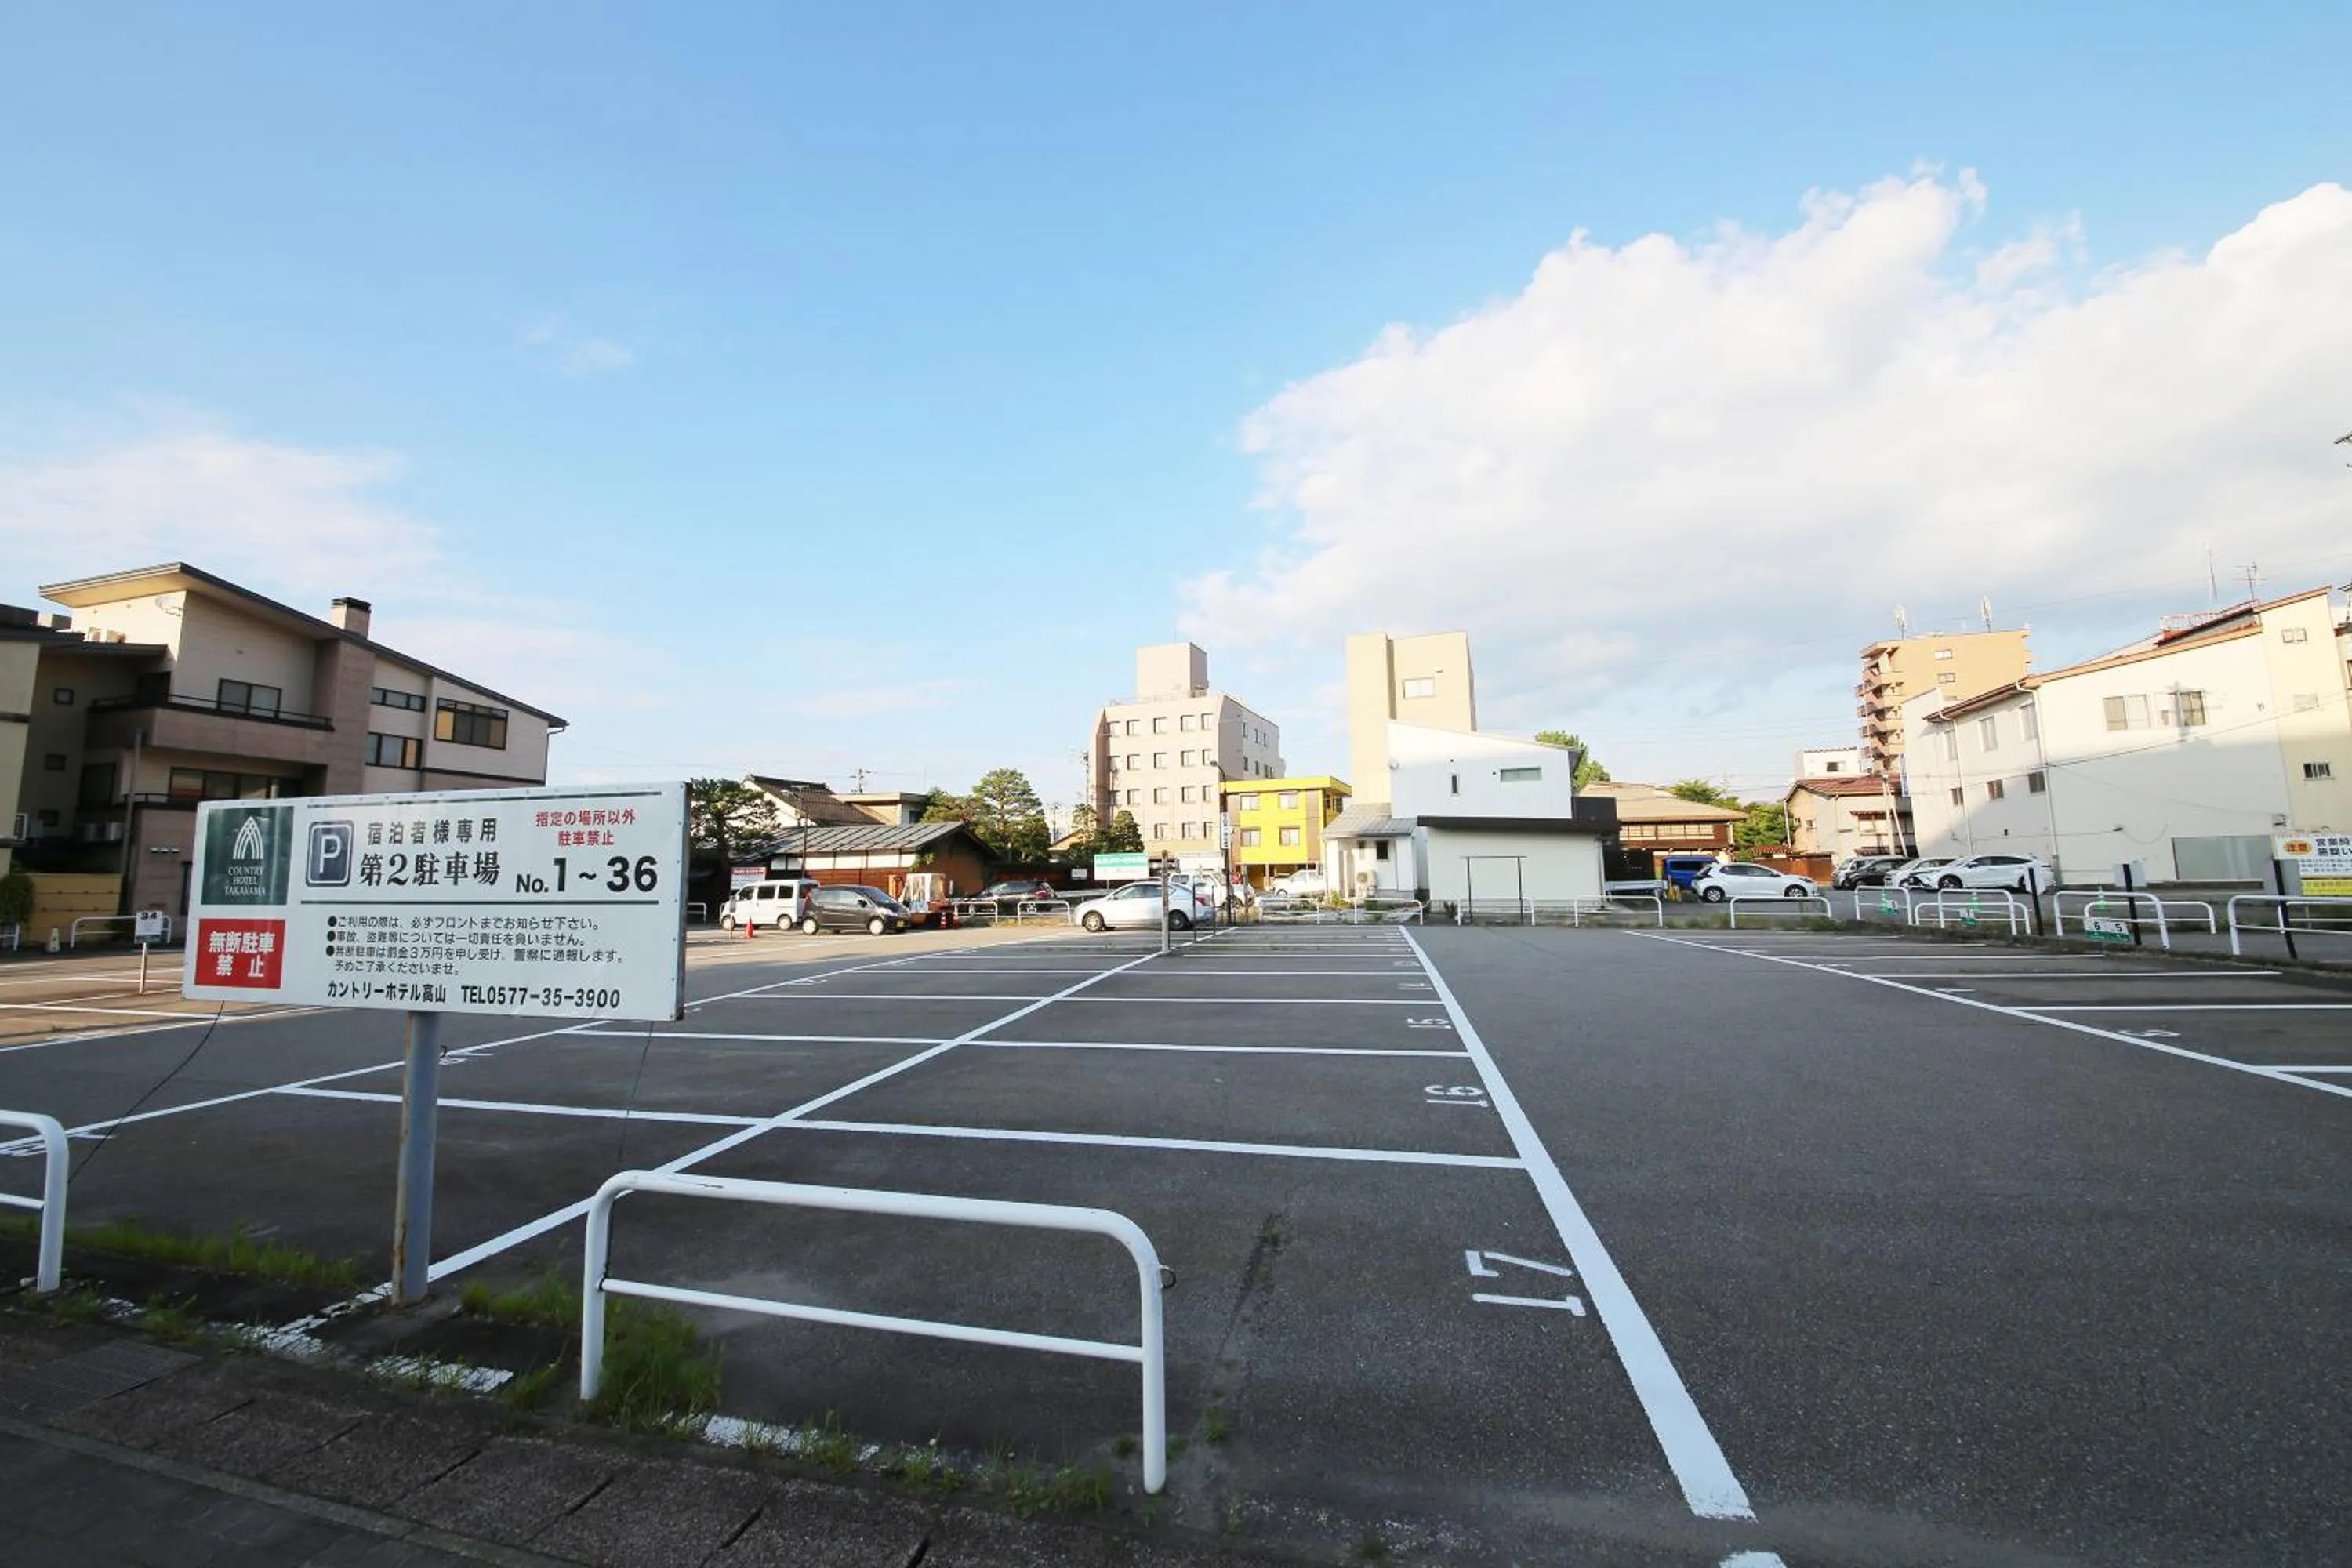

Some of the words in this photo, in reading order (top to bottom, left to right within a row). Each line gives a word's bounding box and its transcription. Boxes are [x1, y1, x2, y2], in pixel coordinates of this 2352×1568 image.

[535, 809, 636, 827] 指定の場所以外
[367, 818, 497, 846] 宿泊者様専用
[557, 829, 615, 847] 駐車禁止
[228, 865, 264, 876] COUNTRY
[233, 876, 258, 886] HOTEL
[359, 851, 501, 887] 第2駐車場
[224, 885, 267, 896] TAKAYAMA
[209, 931, 276, 955] 無断駐車
[327, 980, 447, 1004] カントリーホテル高山
[460, 985, 621, 1009] TEL0577-35-3900
[1424, 1083, 1489, 1108] 16
[1465, 1250, 1586, 1316] 17
